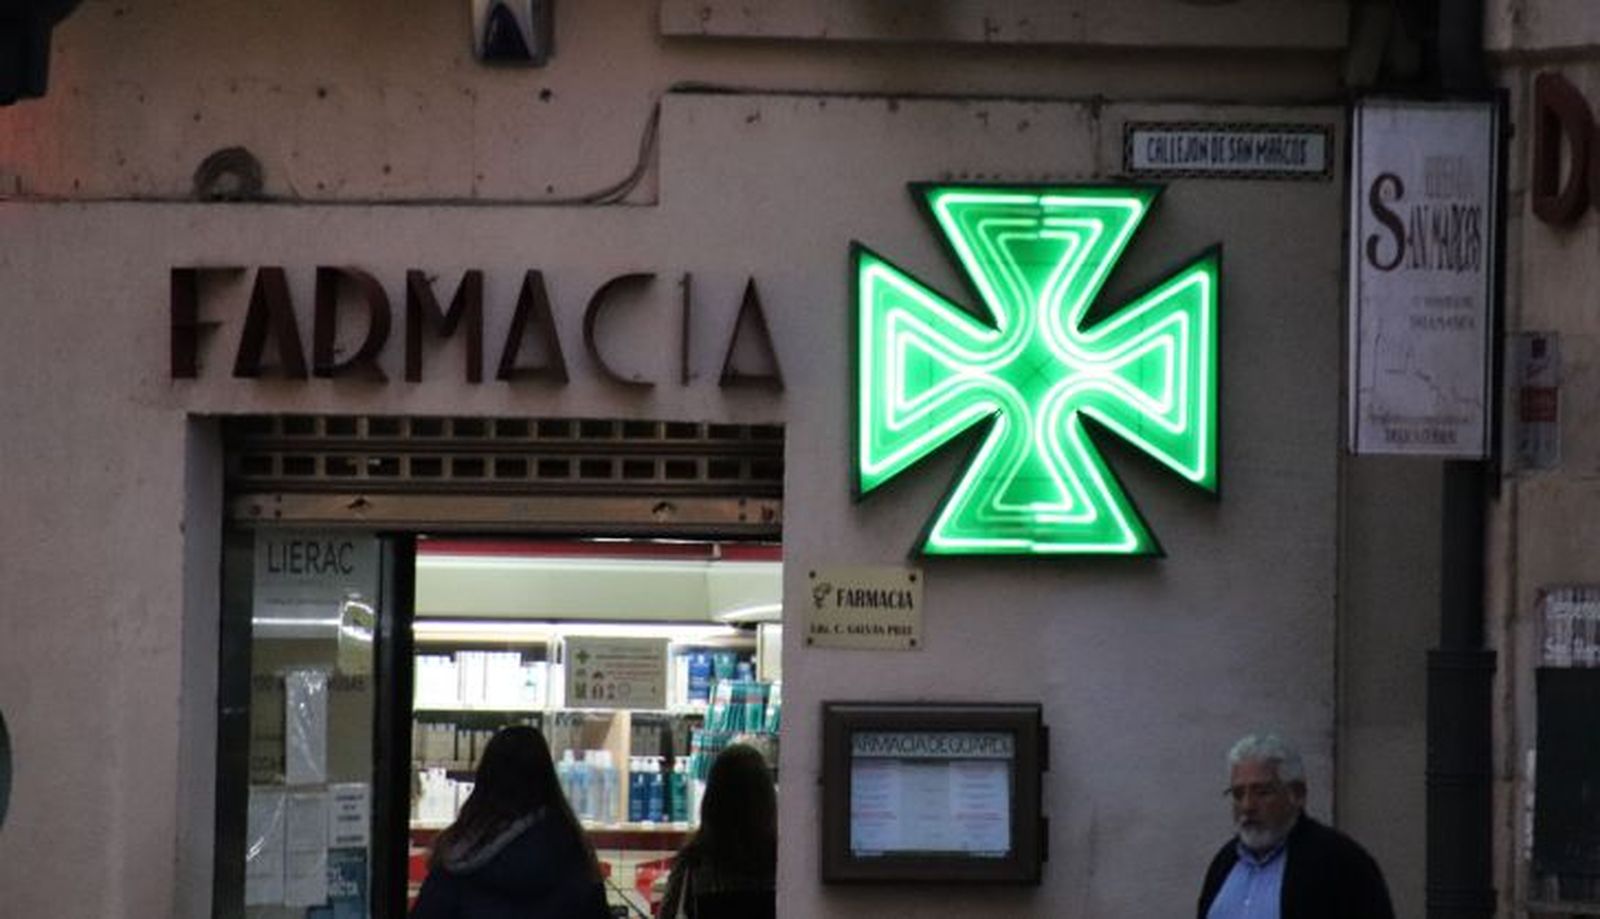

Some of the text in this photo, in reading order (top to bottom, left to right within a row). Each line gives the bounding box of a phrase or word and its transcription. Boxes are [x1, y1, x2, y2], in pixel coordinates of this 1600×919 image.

[1210, 136, 1225, 164] DE
[1229, 137, 1252, 165] SAN
[1255, 137, 1308, 167] MARCOS
[1533, 71, 1600, 232] D
[169, 265, 786, 390] FARMACIA
[267, 541, 354, 575] LIERAC
[836, 586, 914, 610] FARMACIA
[856, 735, 928, 754] ARMACIA
